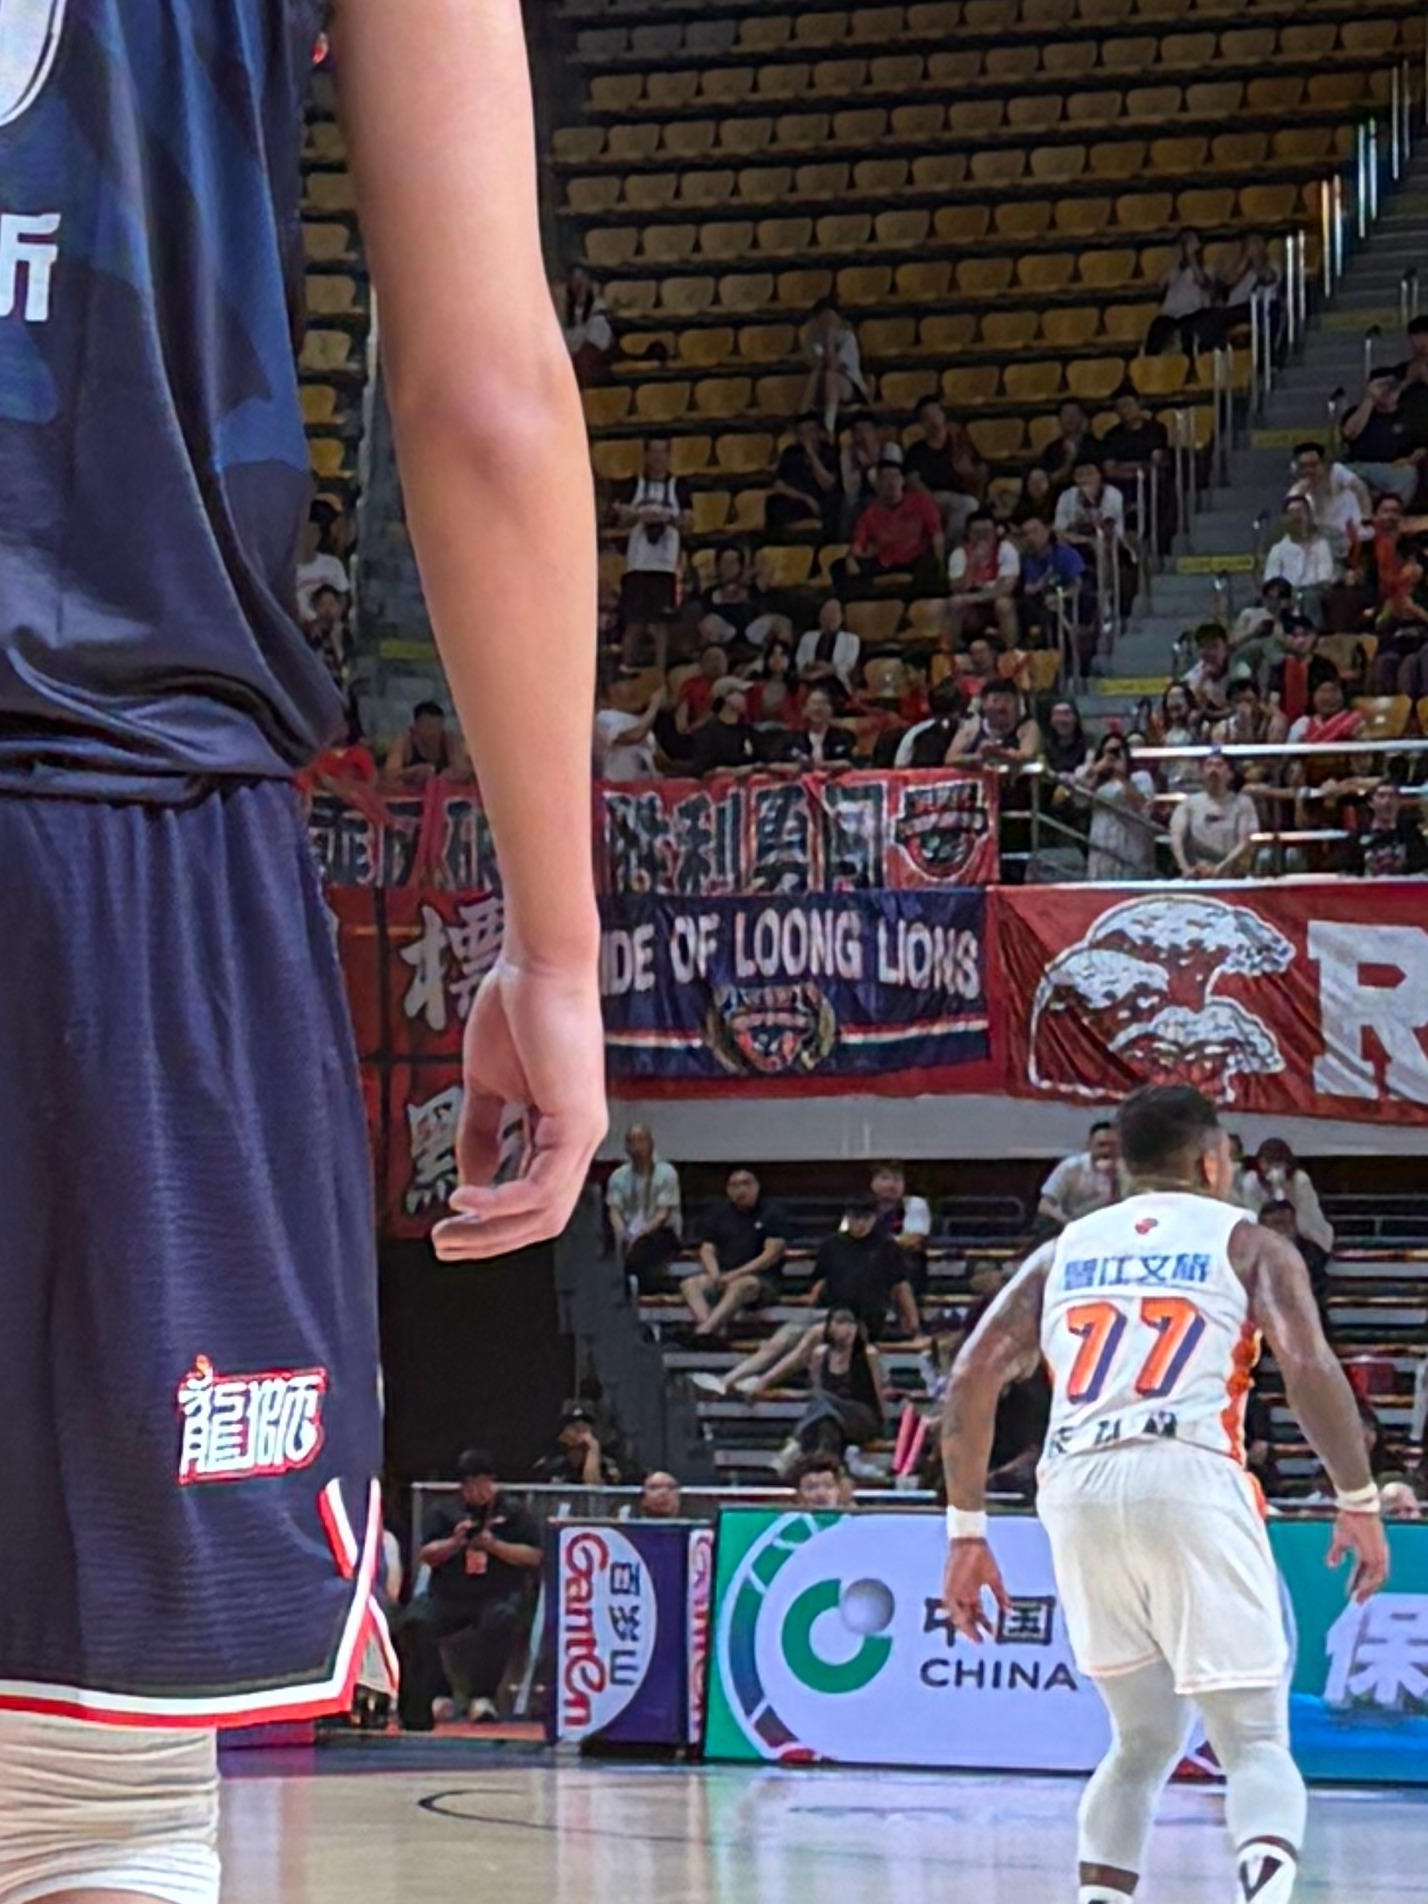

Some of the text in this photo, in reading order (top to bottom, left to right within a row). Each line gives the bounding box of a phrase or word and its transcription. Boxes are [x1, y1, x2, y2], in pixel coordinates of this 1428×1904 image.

[670, 912, 721, 985] OF
[733, 906, 864, 980] LOONG
[877, 916, 982, 999] LIONS
[1066, 1295, 1207, 1406] 77
[608, 1560, 642, 1688] 百岁山
[919, 1657, 1079, 1692] CHINA
